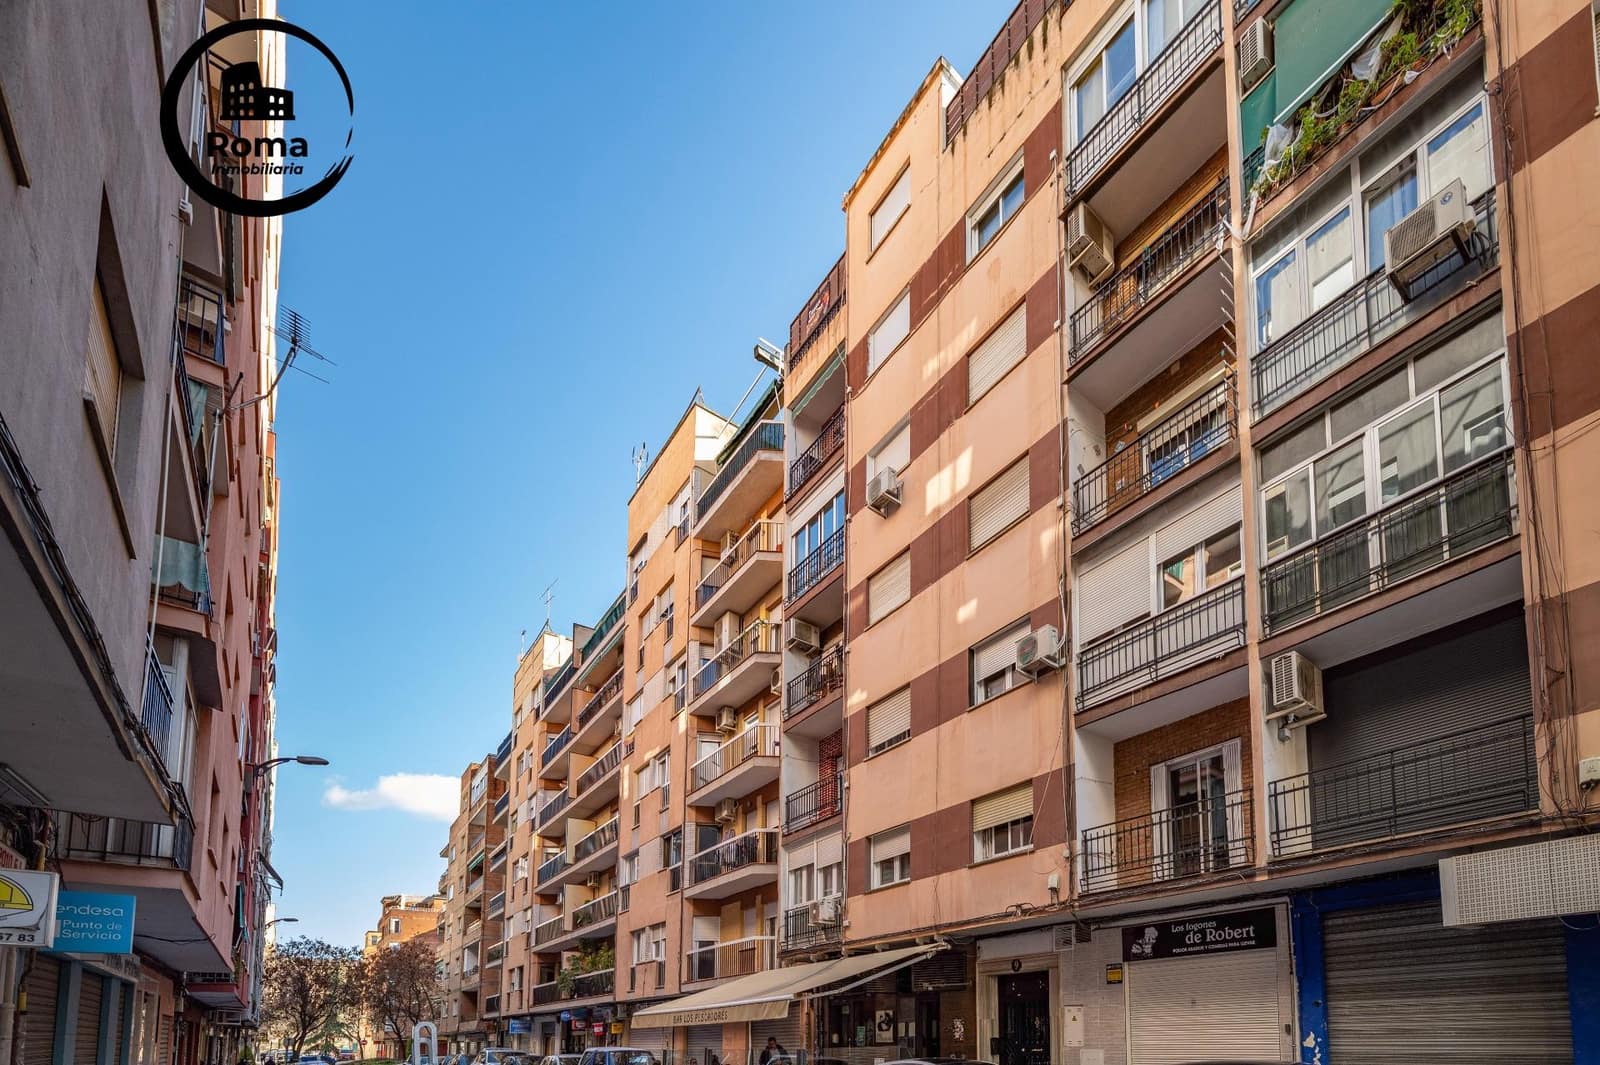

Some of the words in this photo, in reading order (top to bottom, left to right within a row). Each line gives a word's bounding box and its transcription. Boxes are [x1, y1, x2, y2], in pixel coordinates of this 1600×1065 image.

[57, 904, 124, 917] endesa
[63, 919, 103, 929] Punto
[106, 921, 122, 931] de
[1171, 924, 1185, 933] Los
[1186, 920, 1217, 931] fogones
[17, 933, 35, 943] 83
[62, 929, 122, 941] Servicio
[1185, 931, 1202, 944] de
[1206, 925, 1255, 942] Robert
